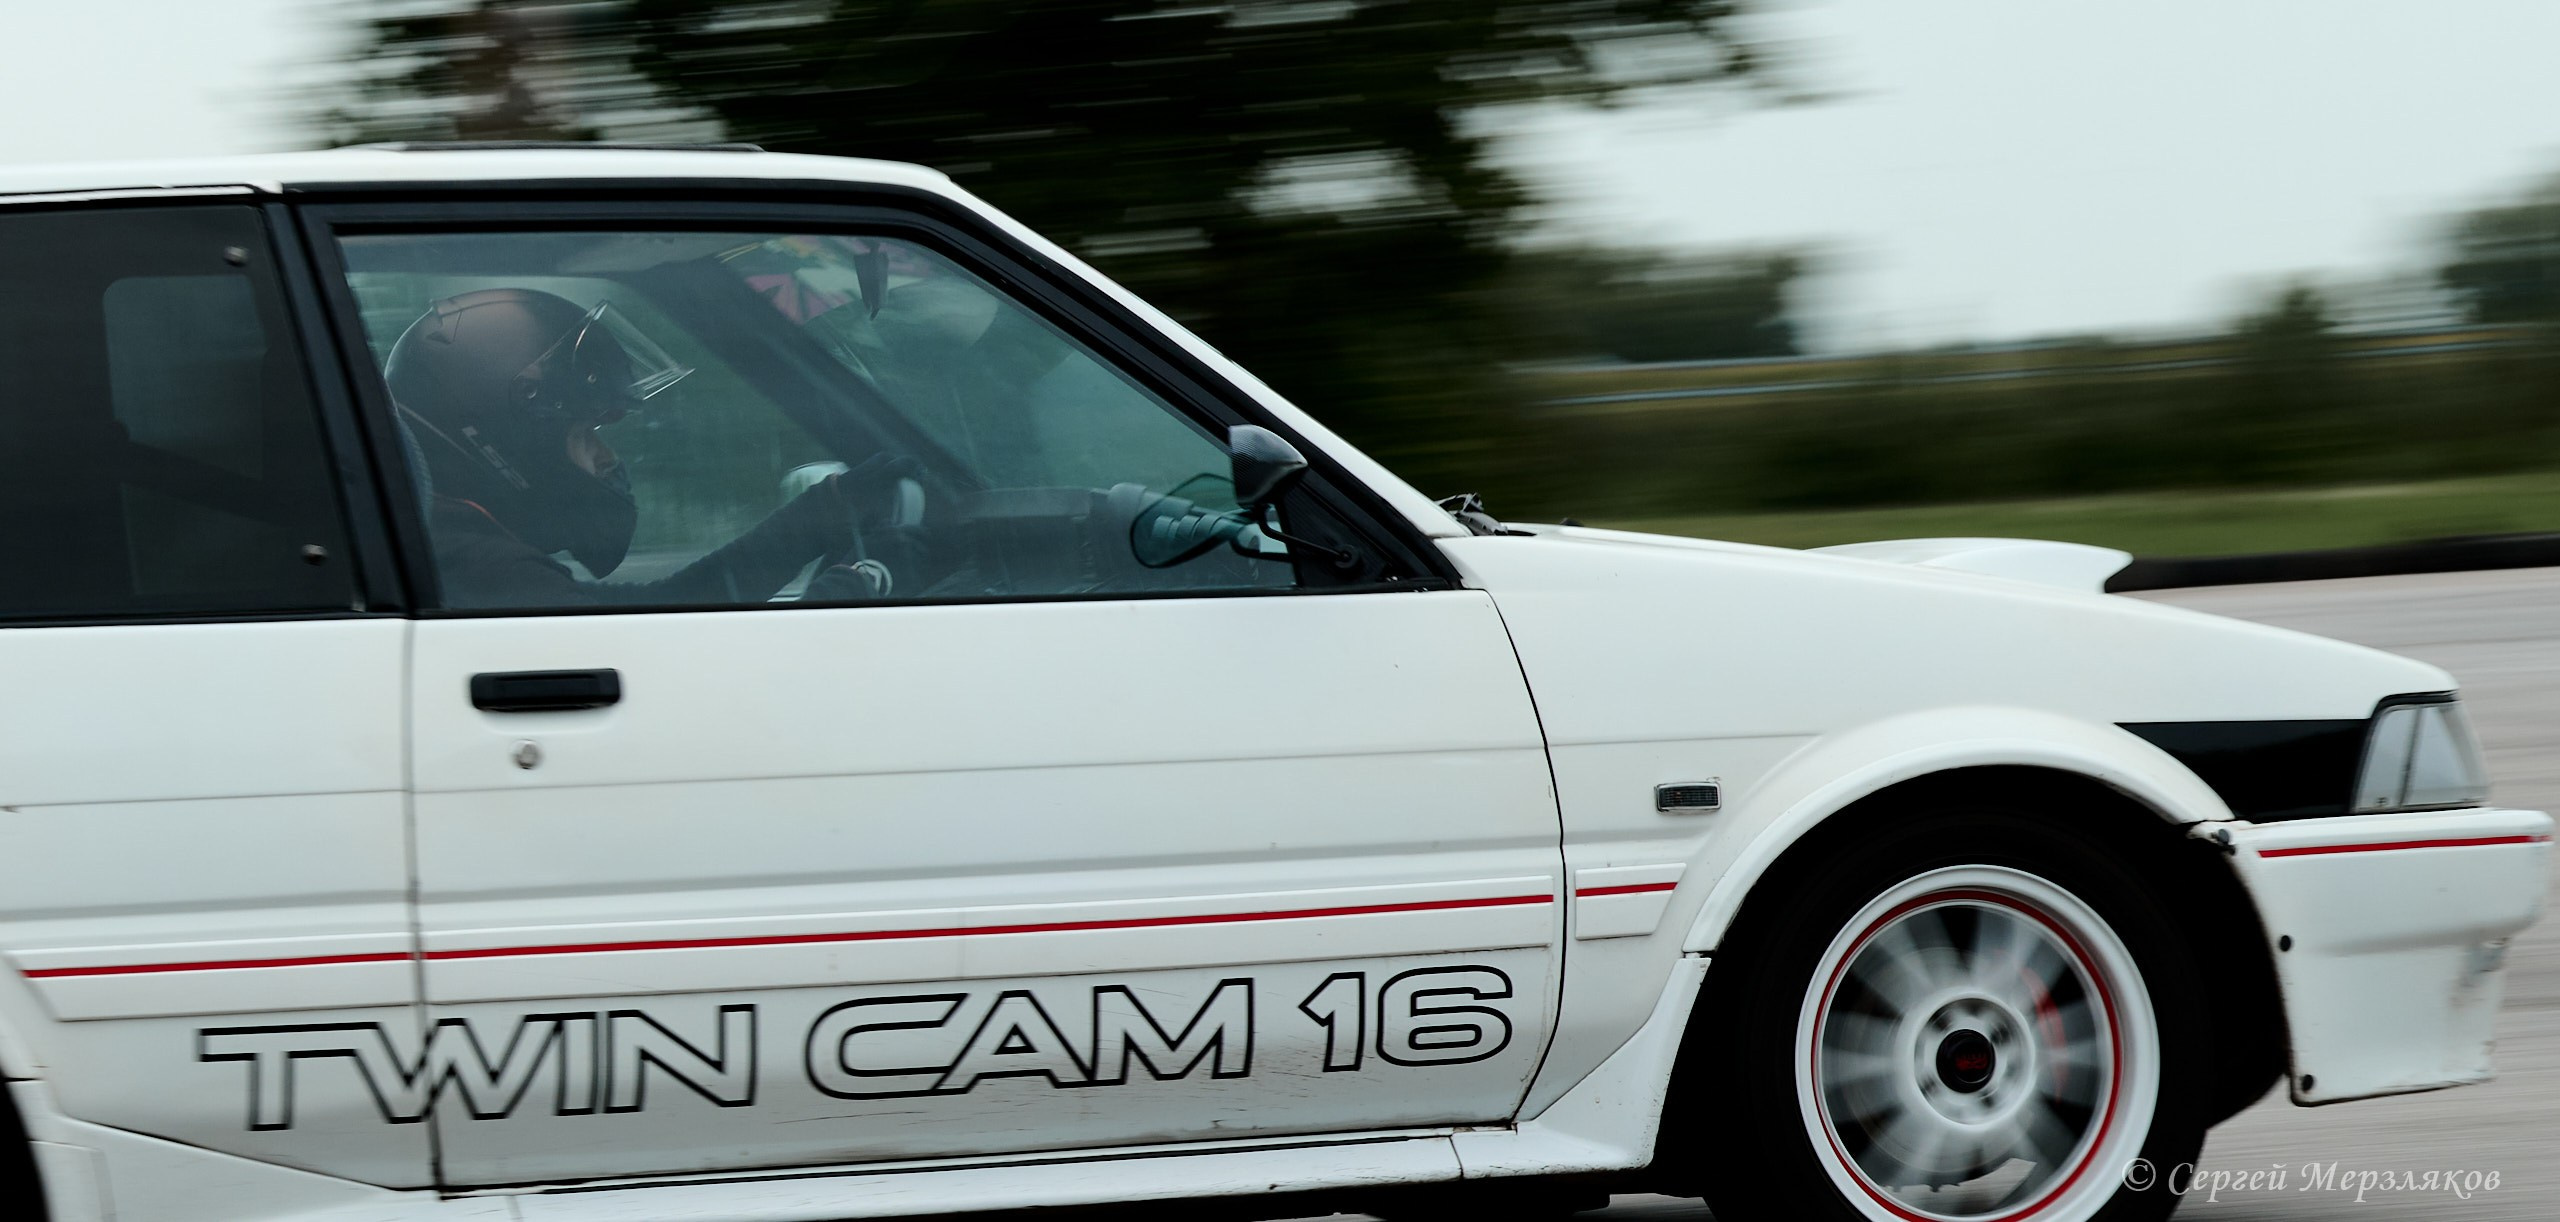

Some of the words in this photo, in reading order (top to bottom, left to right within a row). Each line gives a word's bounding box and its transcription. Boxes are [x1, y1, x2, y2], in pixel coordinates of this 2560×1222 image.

[196, 1003, 759, 1131] TWIN
[804, 977, 1255, 1101] CAM
[1300, 964, 1514, 1073] 16
